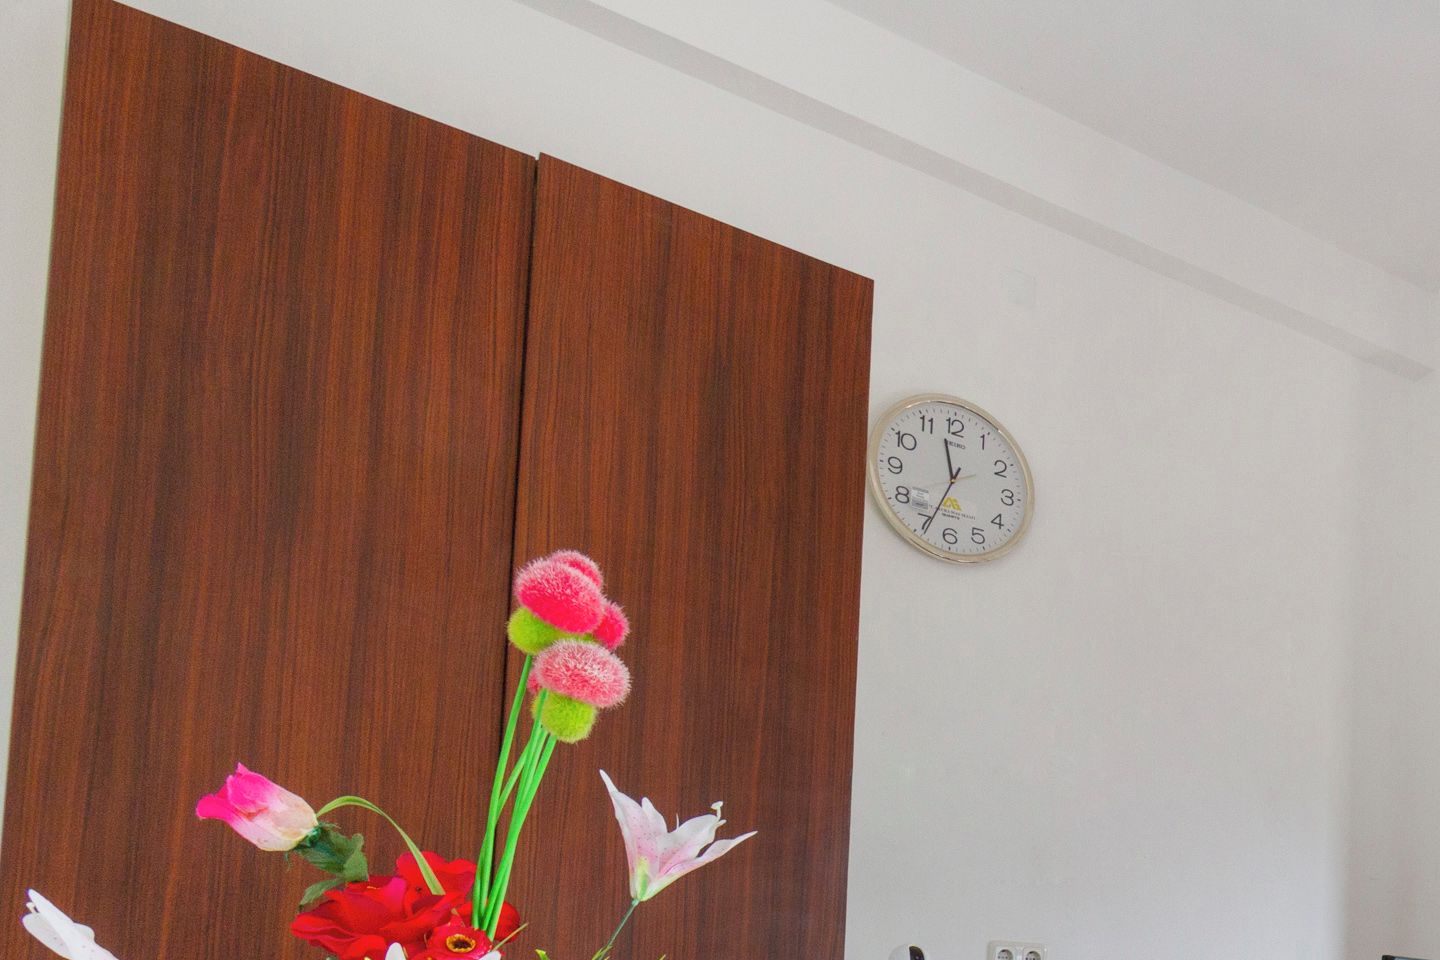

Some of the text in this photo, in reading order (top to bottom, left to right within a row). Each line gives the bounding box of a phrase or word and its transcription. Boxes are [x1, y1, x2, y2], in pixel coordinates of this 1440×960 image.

[920, 415, 934, 434] 11
[946, 417, 965, 438] 12
[895, 430, 917, 451] 10
[946, 440, 966, 450] EIKO
[980, 434, 986, 450] 1
[887, 456, 903, 475] 9
[994, 460, 1008, 478] 2
[895, 486, 910, 504] 8
[1001, 489, 1015, 506] 3
[917, 512, 932, 530] 7
[991, 513, 1004, 530] 4
[942, 528, 958, 545] 6
[971, 527, 986, 545] 5
